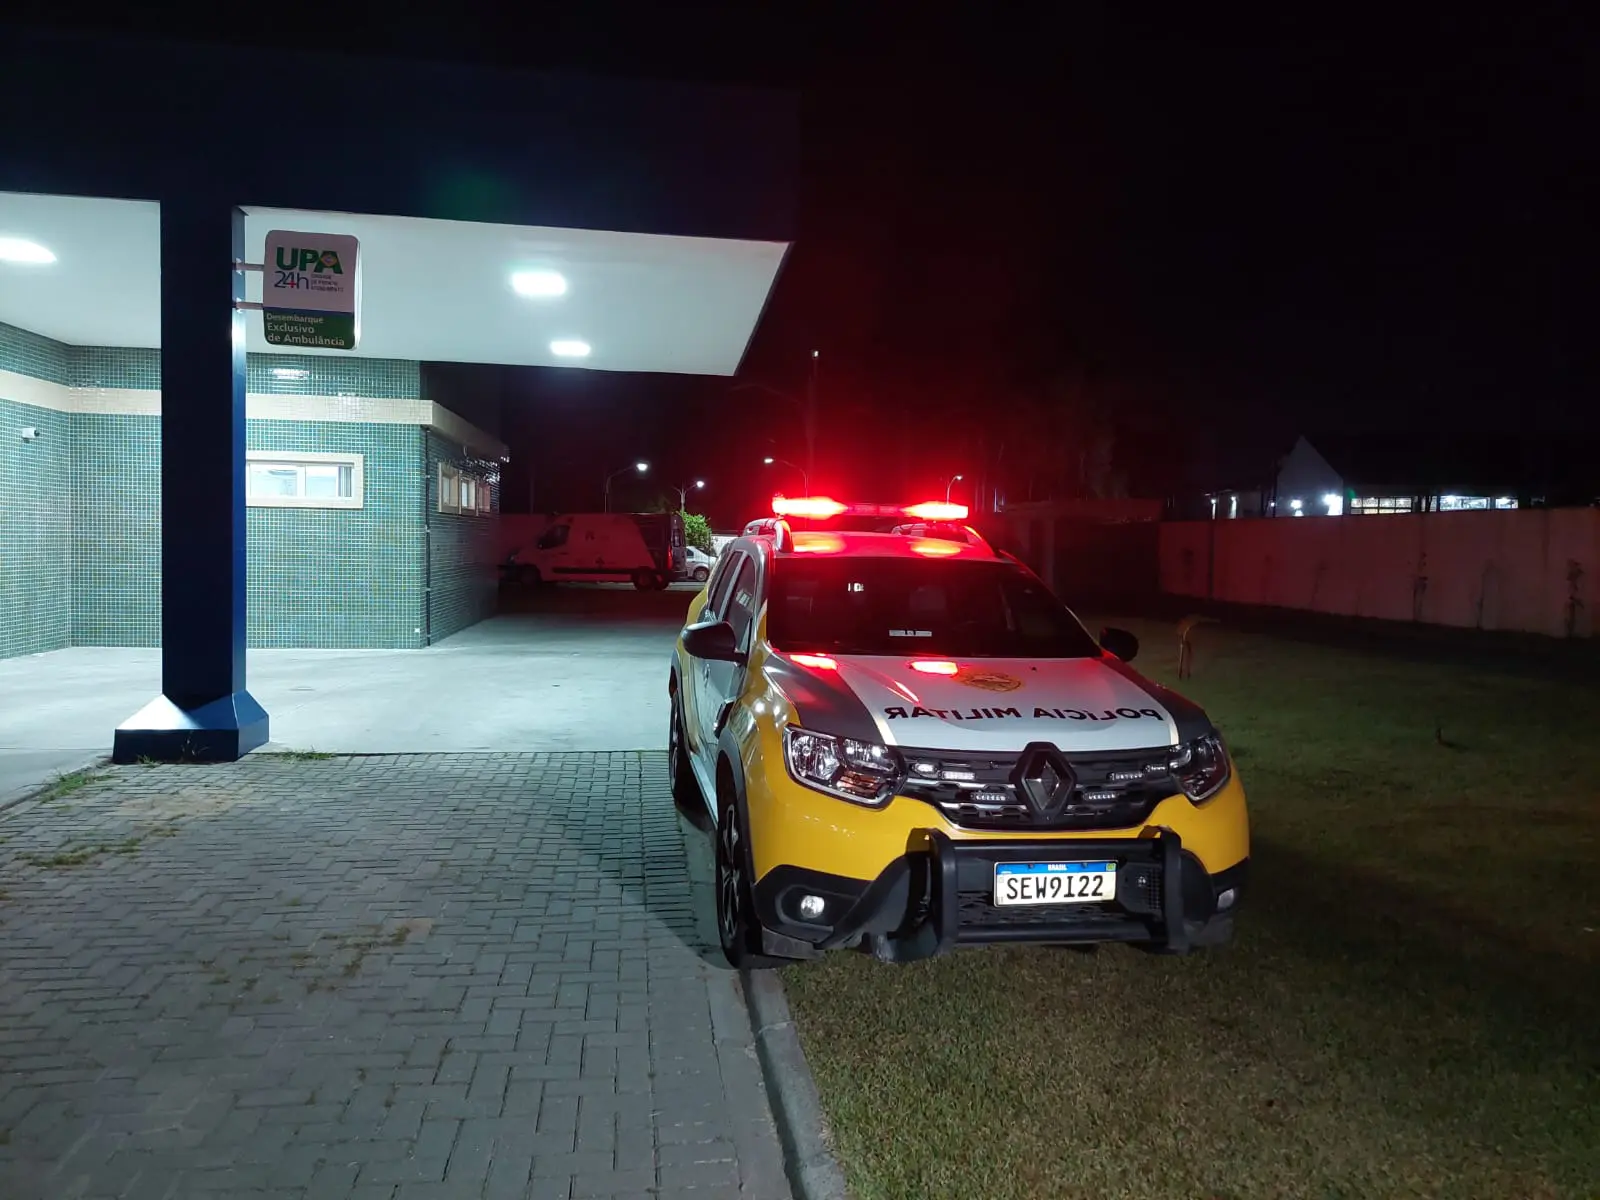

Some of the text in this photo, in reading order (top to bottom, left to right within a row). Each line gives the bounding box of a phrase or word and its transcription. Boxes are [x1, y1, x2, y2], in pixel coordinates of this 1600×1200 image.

[277, 247, 343, 274] UPA
[274, 271, 309, 290] 24h
[266, 313, 324, 324] Desembarque
[267, 323, 315, 334] Exclusivo
[267, 334, 345, 346] de Ambulância
